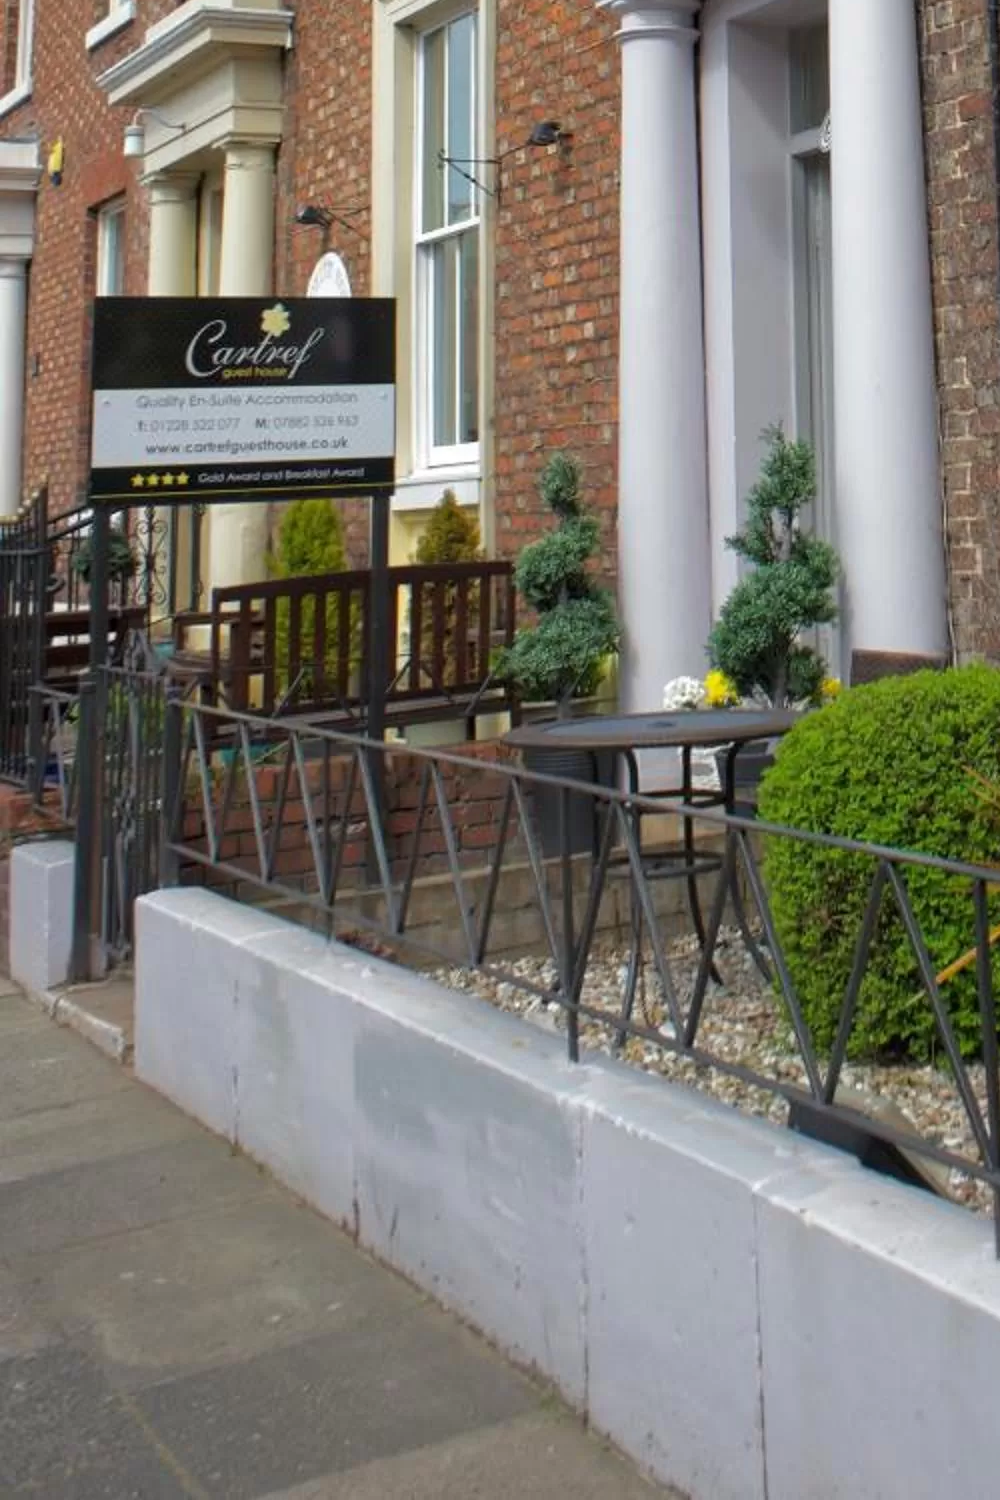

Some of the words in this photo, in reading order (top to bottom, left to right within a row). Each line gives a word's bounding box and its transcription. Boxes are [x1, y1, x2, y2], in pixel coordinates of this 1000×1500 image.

[185, 319, 325, 379] Cartref
[136, 395, 185, 412] Quality
[245, 391, 358, 406] Accommodation
[145, 435, 348, 455] www.cartrefguesthouse.co.uk
[198, 472, 224, 483] Gold
[226, 471, 260, 482] Award
[261, 470, 283, 481] and
[331, 466, 365, 478] Award
